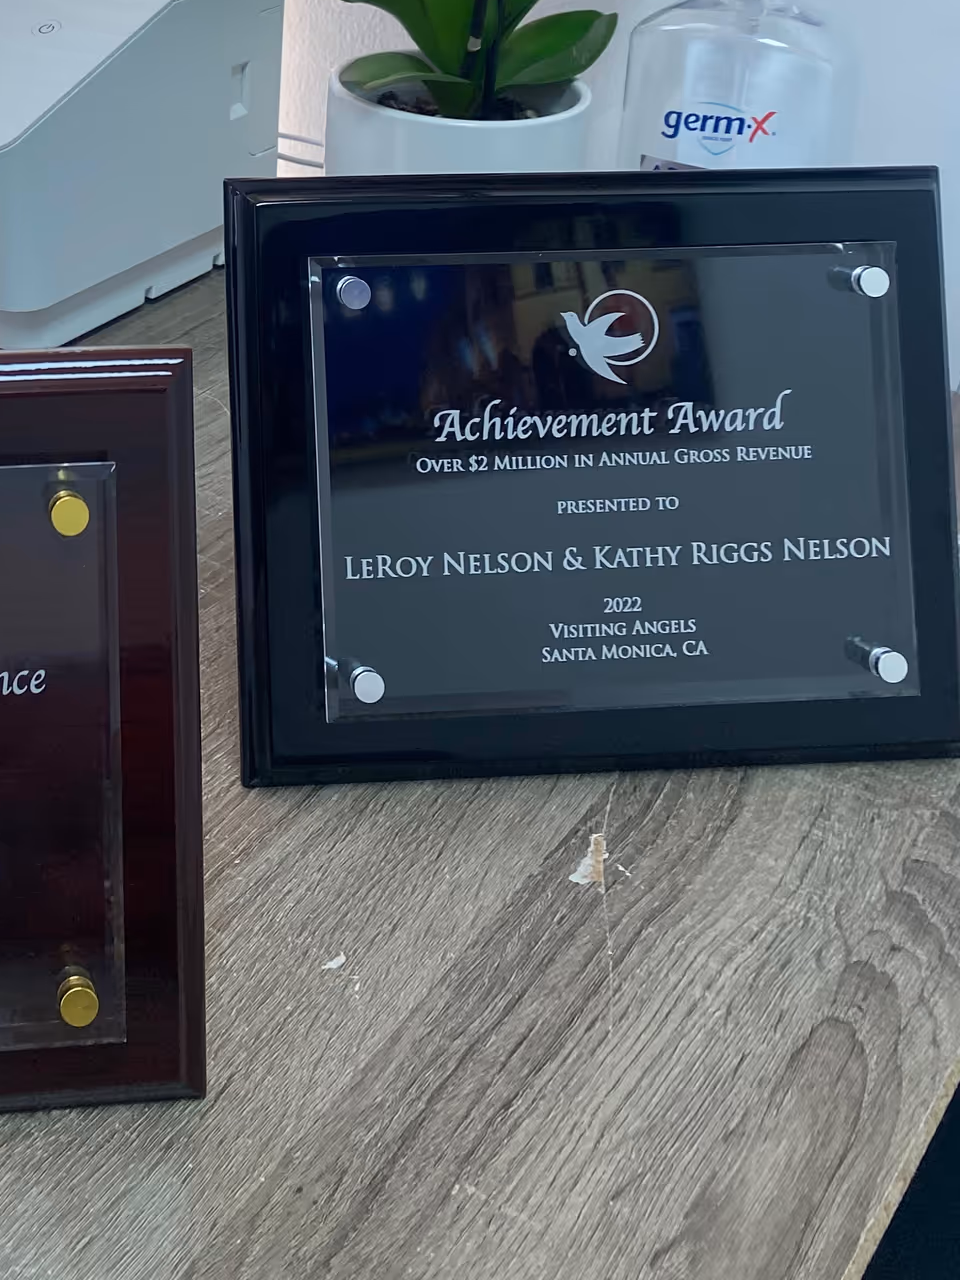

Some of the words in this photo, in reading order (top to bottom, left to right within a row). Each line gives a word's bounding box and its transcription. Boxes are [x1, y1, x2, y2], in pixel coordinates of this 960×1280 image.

[433, 399, 658, 442] Achievement
[667, 389, 792, 434] Award
[468, 454, 489, 473] $2
[557, 497, 651, 514] PRESENTED
[655, 496, 679, 510] TO
[562, 547, 587, 571] &
[603, 596, 642, 613] 2022
[682, 640, 709, 656] CA
